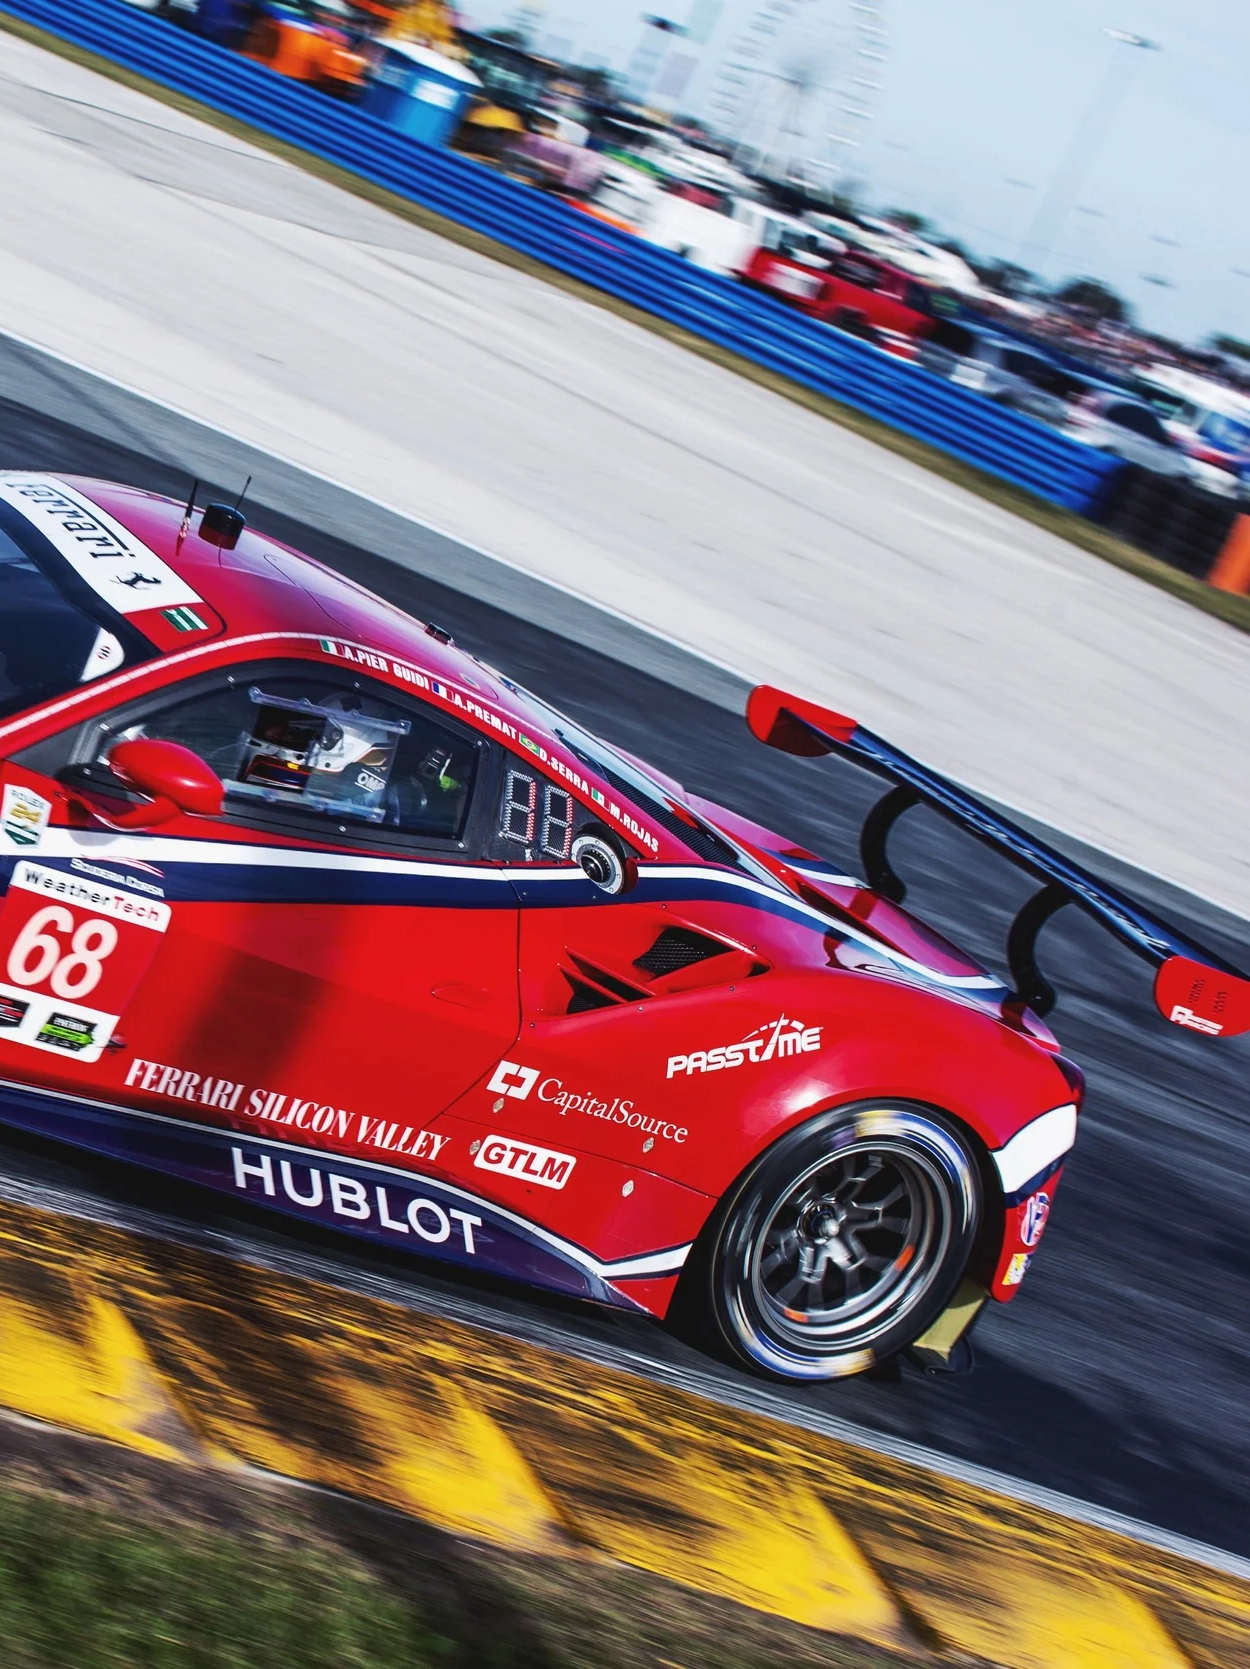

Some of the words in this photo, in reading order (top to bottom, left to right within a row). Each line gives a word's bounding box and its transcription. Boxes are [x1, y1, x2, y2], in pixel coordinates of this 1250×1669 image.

[343, 646, 389, 673] A.PIER
[392, 663, 430, 690] GUIDI
[453, 693, 518, 740] A.PREMAT
[538, 747, 589, 796] D.SERRA
[609, 804, 659, 853] M.ROJAS
[24, 867, 161, 922] WeatherTech
[6, 905, 119, 1000] 68
[123, 1058, 246, 1112] FERRARI
[243, 1088, 357, 1139] SILICON
[356, 1115, 452, 1162] VALLEY
[536, 1077, 690, 1144] CapitalSource
[230, 1146, 483, 1256] HUBLOT
[482, 1142, 571, 1184] GTLM
